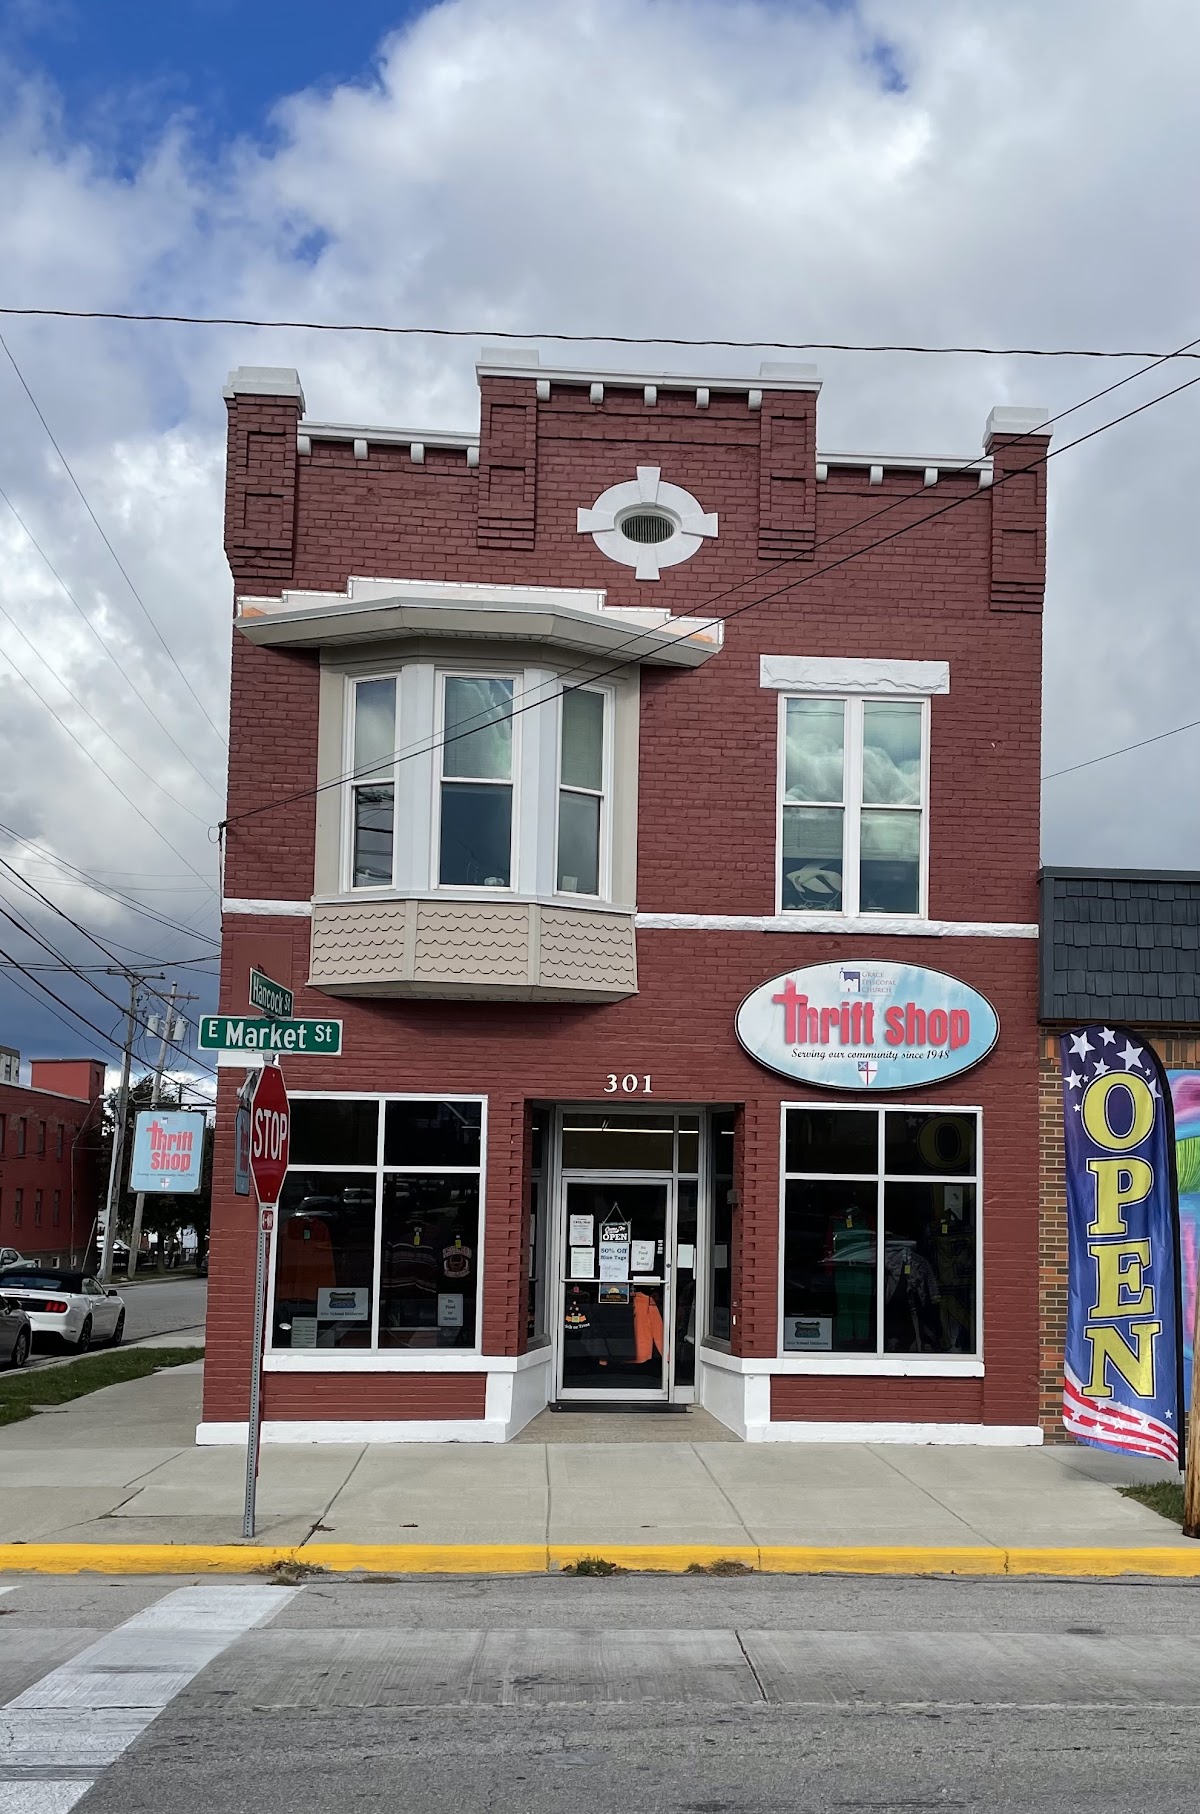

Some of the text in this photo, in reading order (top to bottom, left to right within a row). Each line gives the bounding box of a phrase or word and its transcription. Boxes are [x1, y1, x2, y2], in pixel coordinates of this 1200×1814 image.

[252, 974, 291, 1015] Hancock St
[861, 978, 897, 986] EPISCOPAL
[772, 977, 970, 1050] thrift shop
[208, 1020, 333, 1049] E Market St
[791, 1048, 950, 1061] Serving our community since 1948
[603, 1073, 654, 1093] 301
[146, 1120, 193, 1151] thrift
[253, 1107, 288, 1161] STOP
[150, 1150, 191, 1172] shop
[602, 1233, 628, 1241] OPEN
[1080, 1070, 1162, 1400] OPEN
